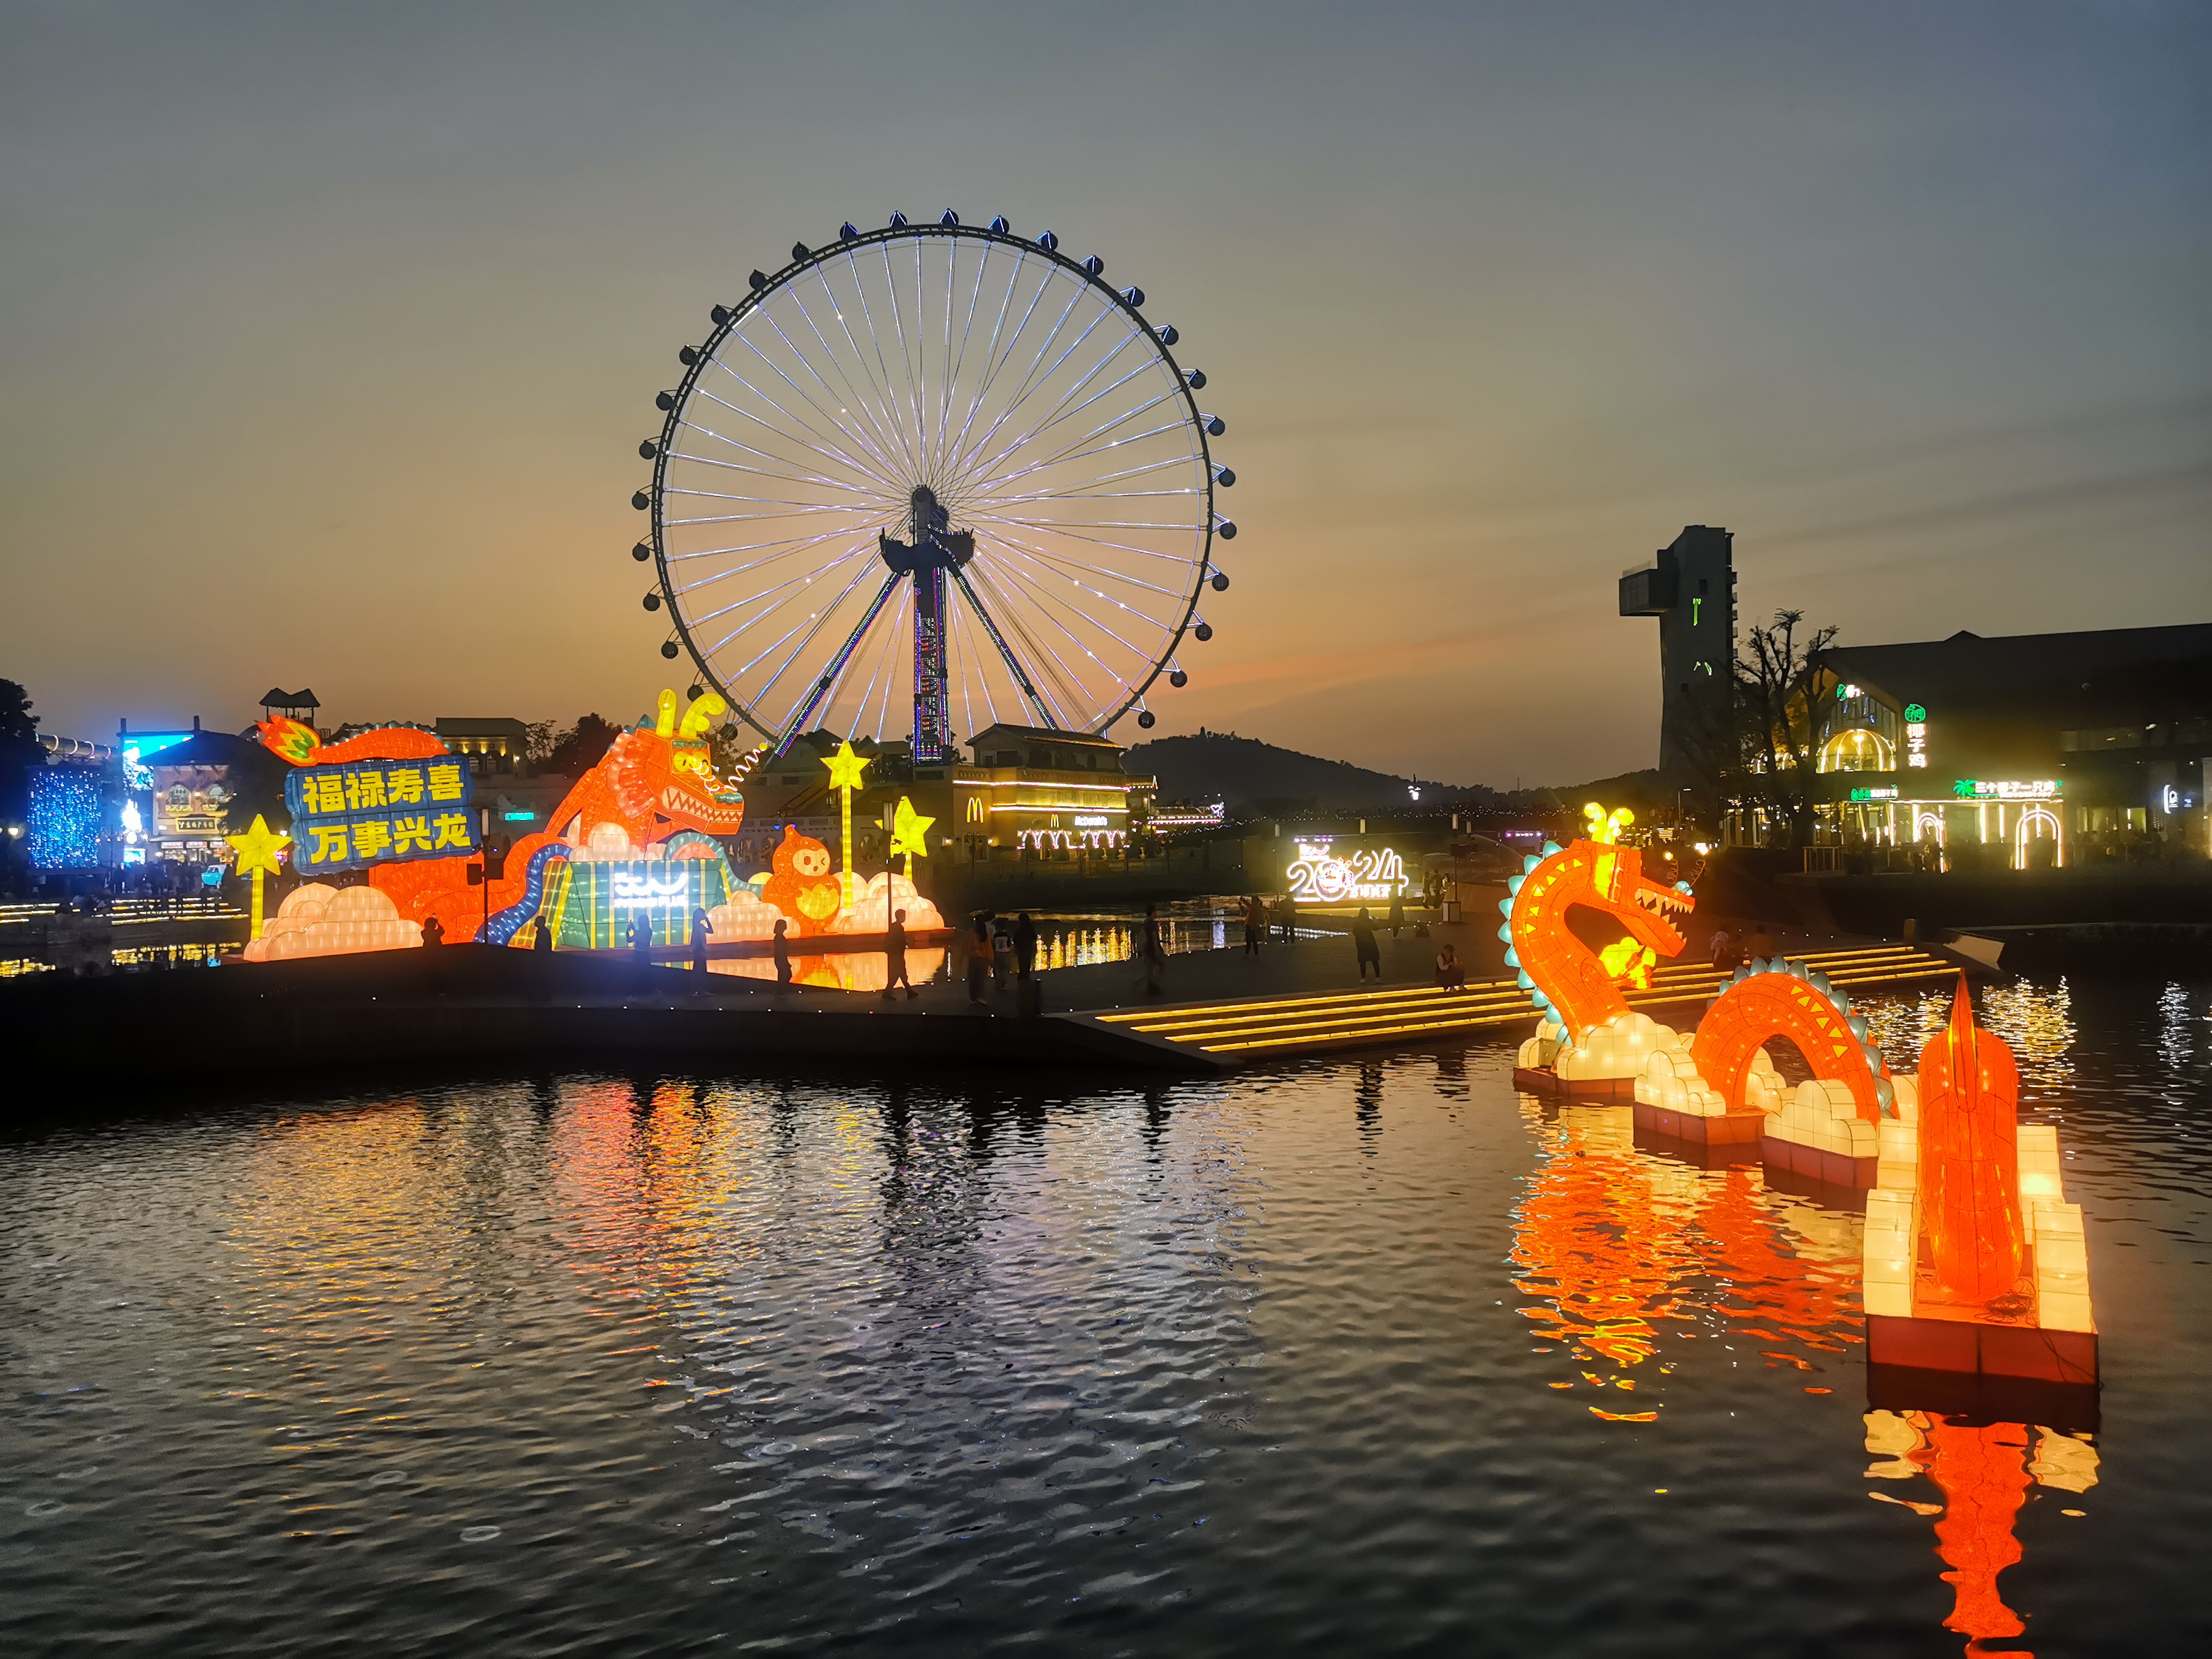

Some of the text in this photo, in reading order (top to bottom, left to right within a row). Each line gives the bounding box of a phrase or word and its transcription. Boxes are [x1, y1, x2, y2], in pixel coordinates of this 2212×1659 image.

[1907, 723, 1926, 768] 椰子鸡
[303, 765, 463, 814] 福禄寿喜
[309, 813, 471, 864] 万事兴龙
[1074, 815, 1108, 826] McDonald's
[1286, 848, 1410, 902] 2024
